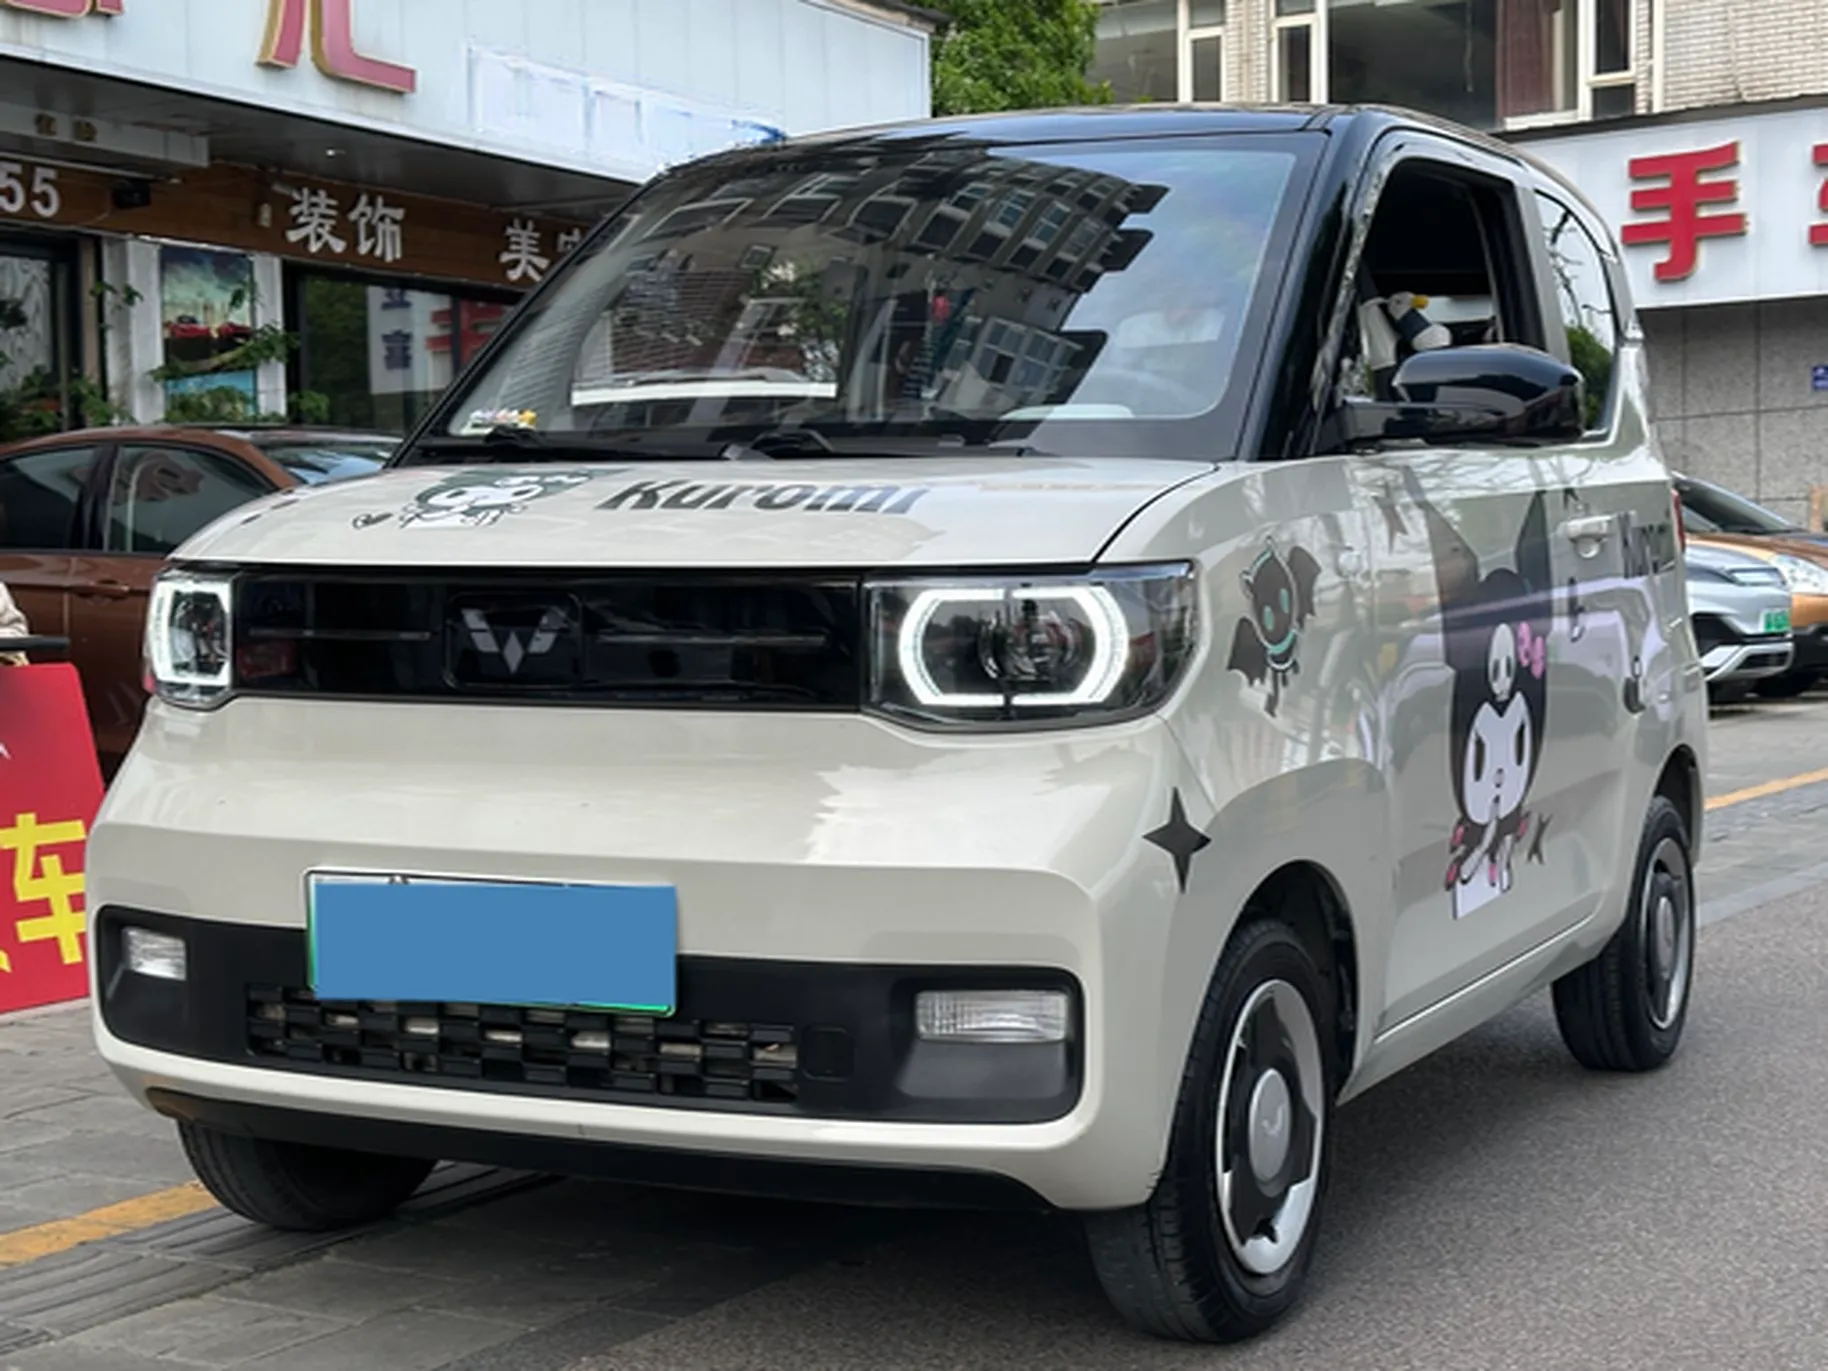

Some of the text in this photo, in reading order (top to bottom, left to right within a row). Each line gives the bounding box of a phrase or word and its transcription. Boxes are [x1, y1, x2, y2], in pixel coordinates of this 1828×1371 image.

[285, 187, 405, 263] 装饰
[1620, 141, 1828, 282] 手
[595, 479, 931, 515] Kuromi
[0, 812, 87, 973] 车
